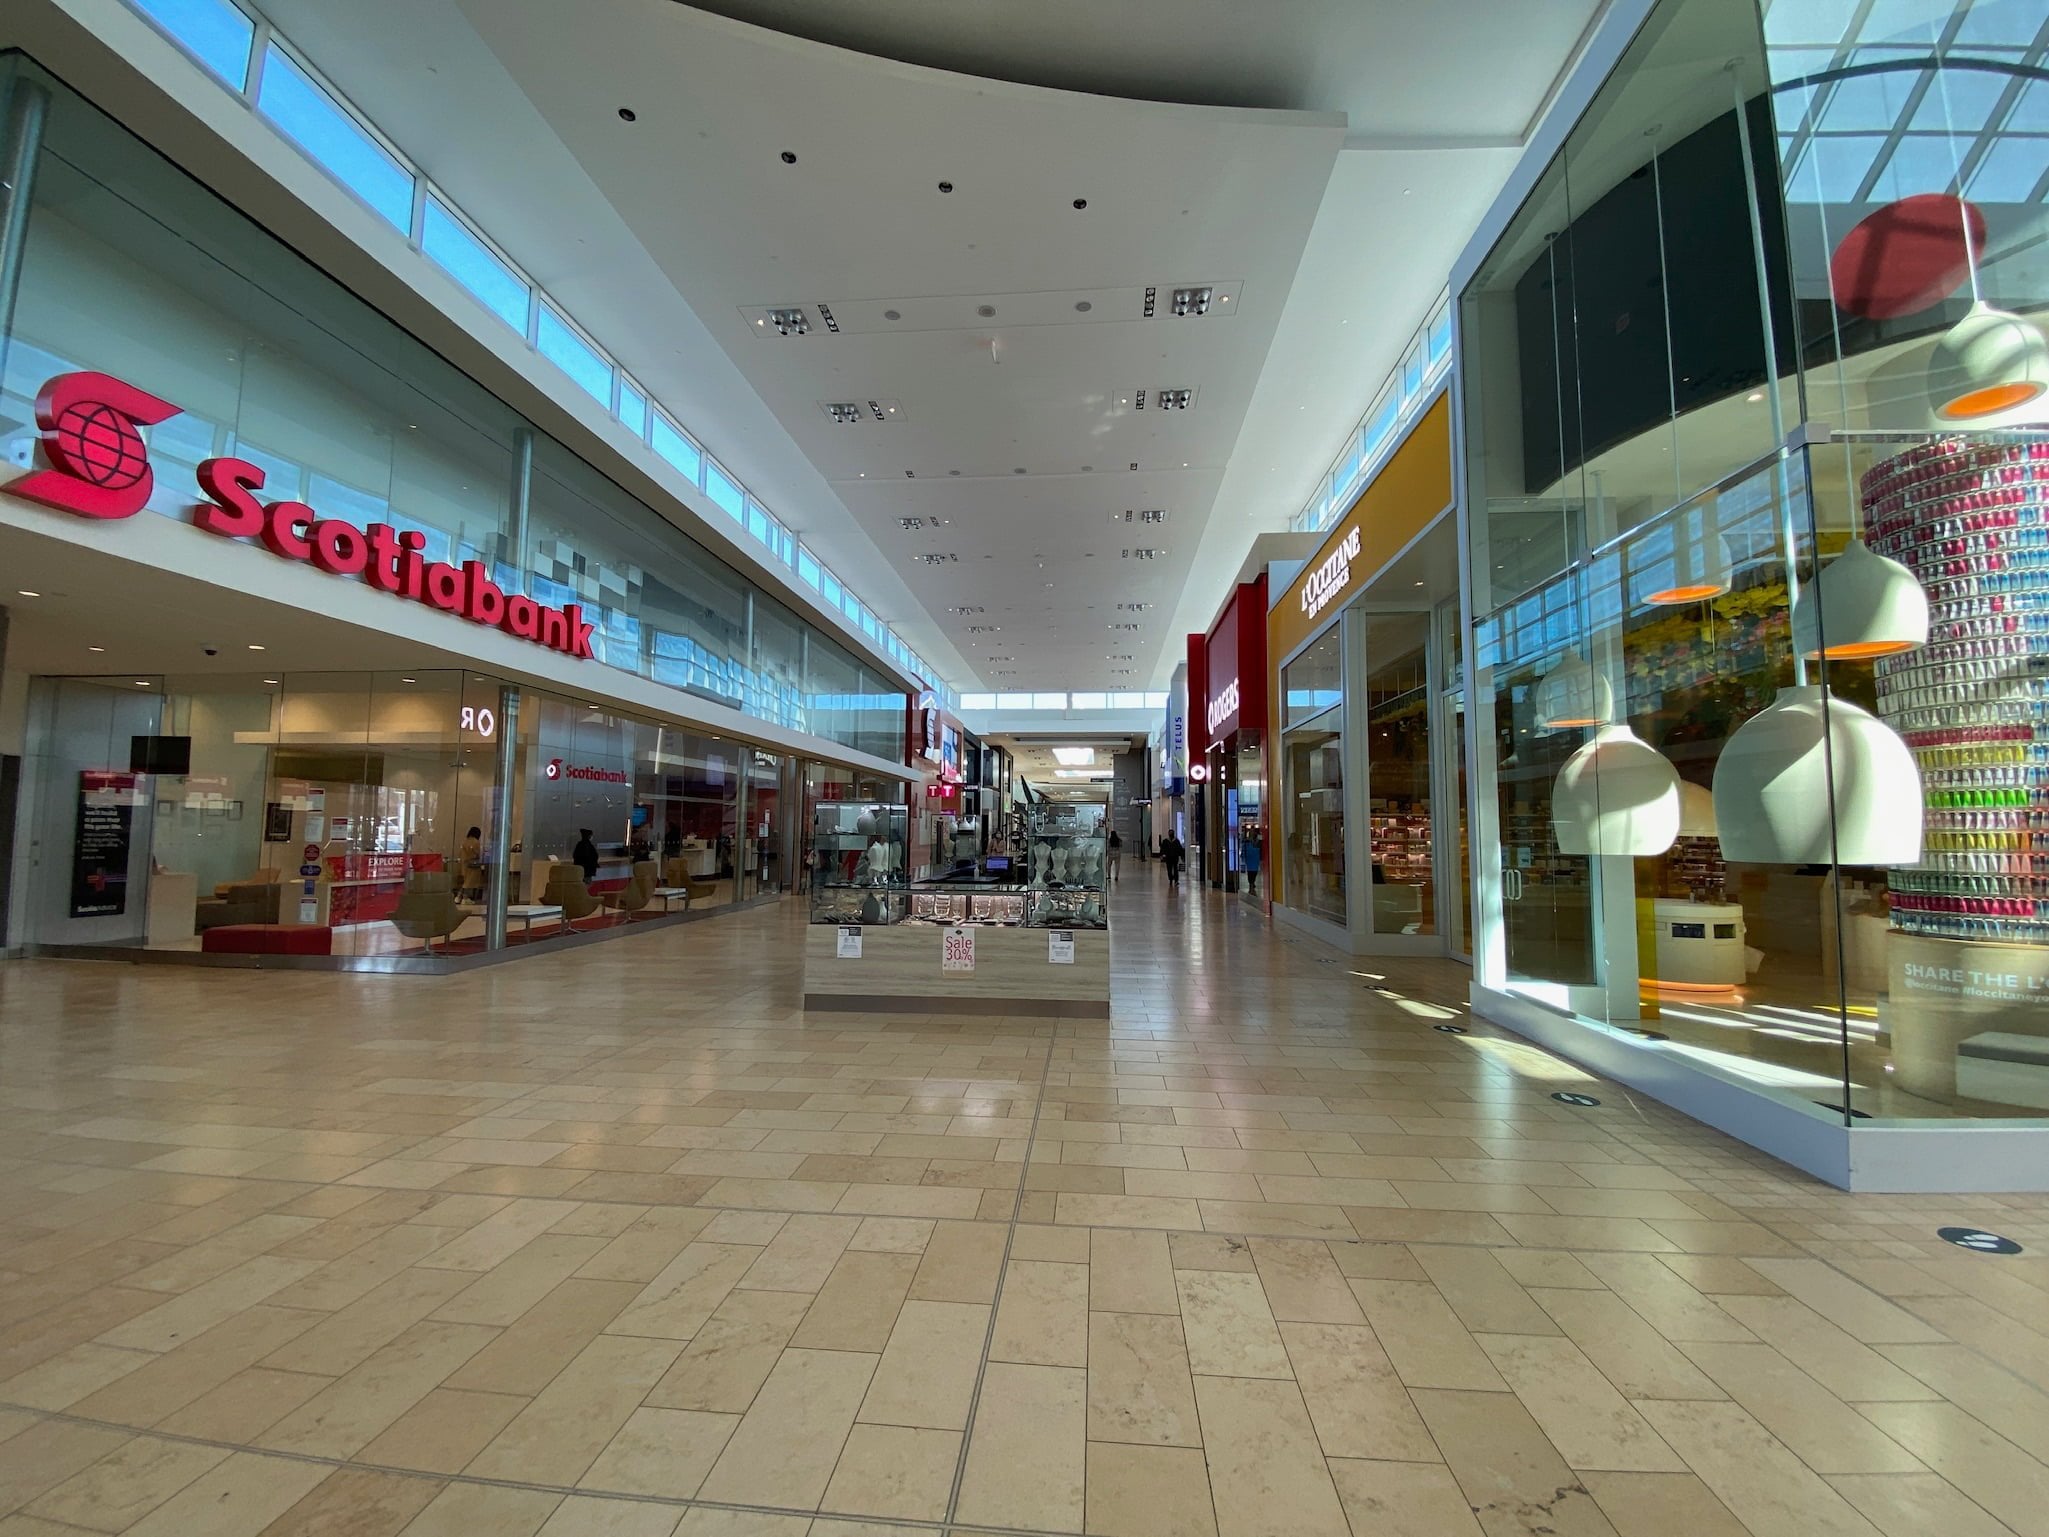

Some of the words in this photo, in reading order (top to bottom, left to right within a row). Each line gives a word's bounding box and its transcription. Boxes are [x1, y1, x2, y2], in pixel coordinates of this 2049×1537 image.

[192, 457, 596, 660] Scotiabank
[1301, 525, 1361, 612] L'OCCITANE
[1308, 602, 1318, 620] EN
[1317, 566, 1351, 611] PROVENCE
[1213, 677, 1239, 729] ROGERS
[1174, 716, 1182, 751] TELUS
[566, 764, 627, 784] Scotiabank
[368, 856, 404, 867] EXPLORE
[945, 935, 972, 949] Sale
[945, 948, 972, 961] 30%
[1904, 963, 1964, 983] SHARE
[1967, 970, 2019, 988] THE
[1904, 977, 1960, 994] @loccitane
